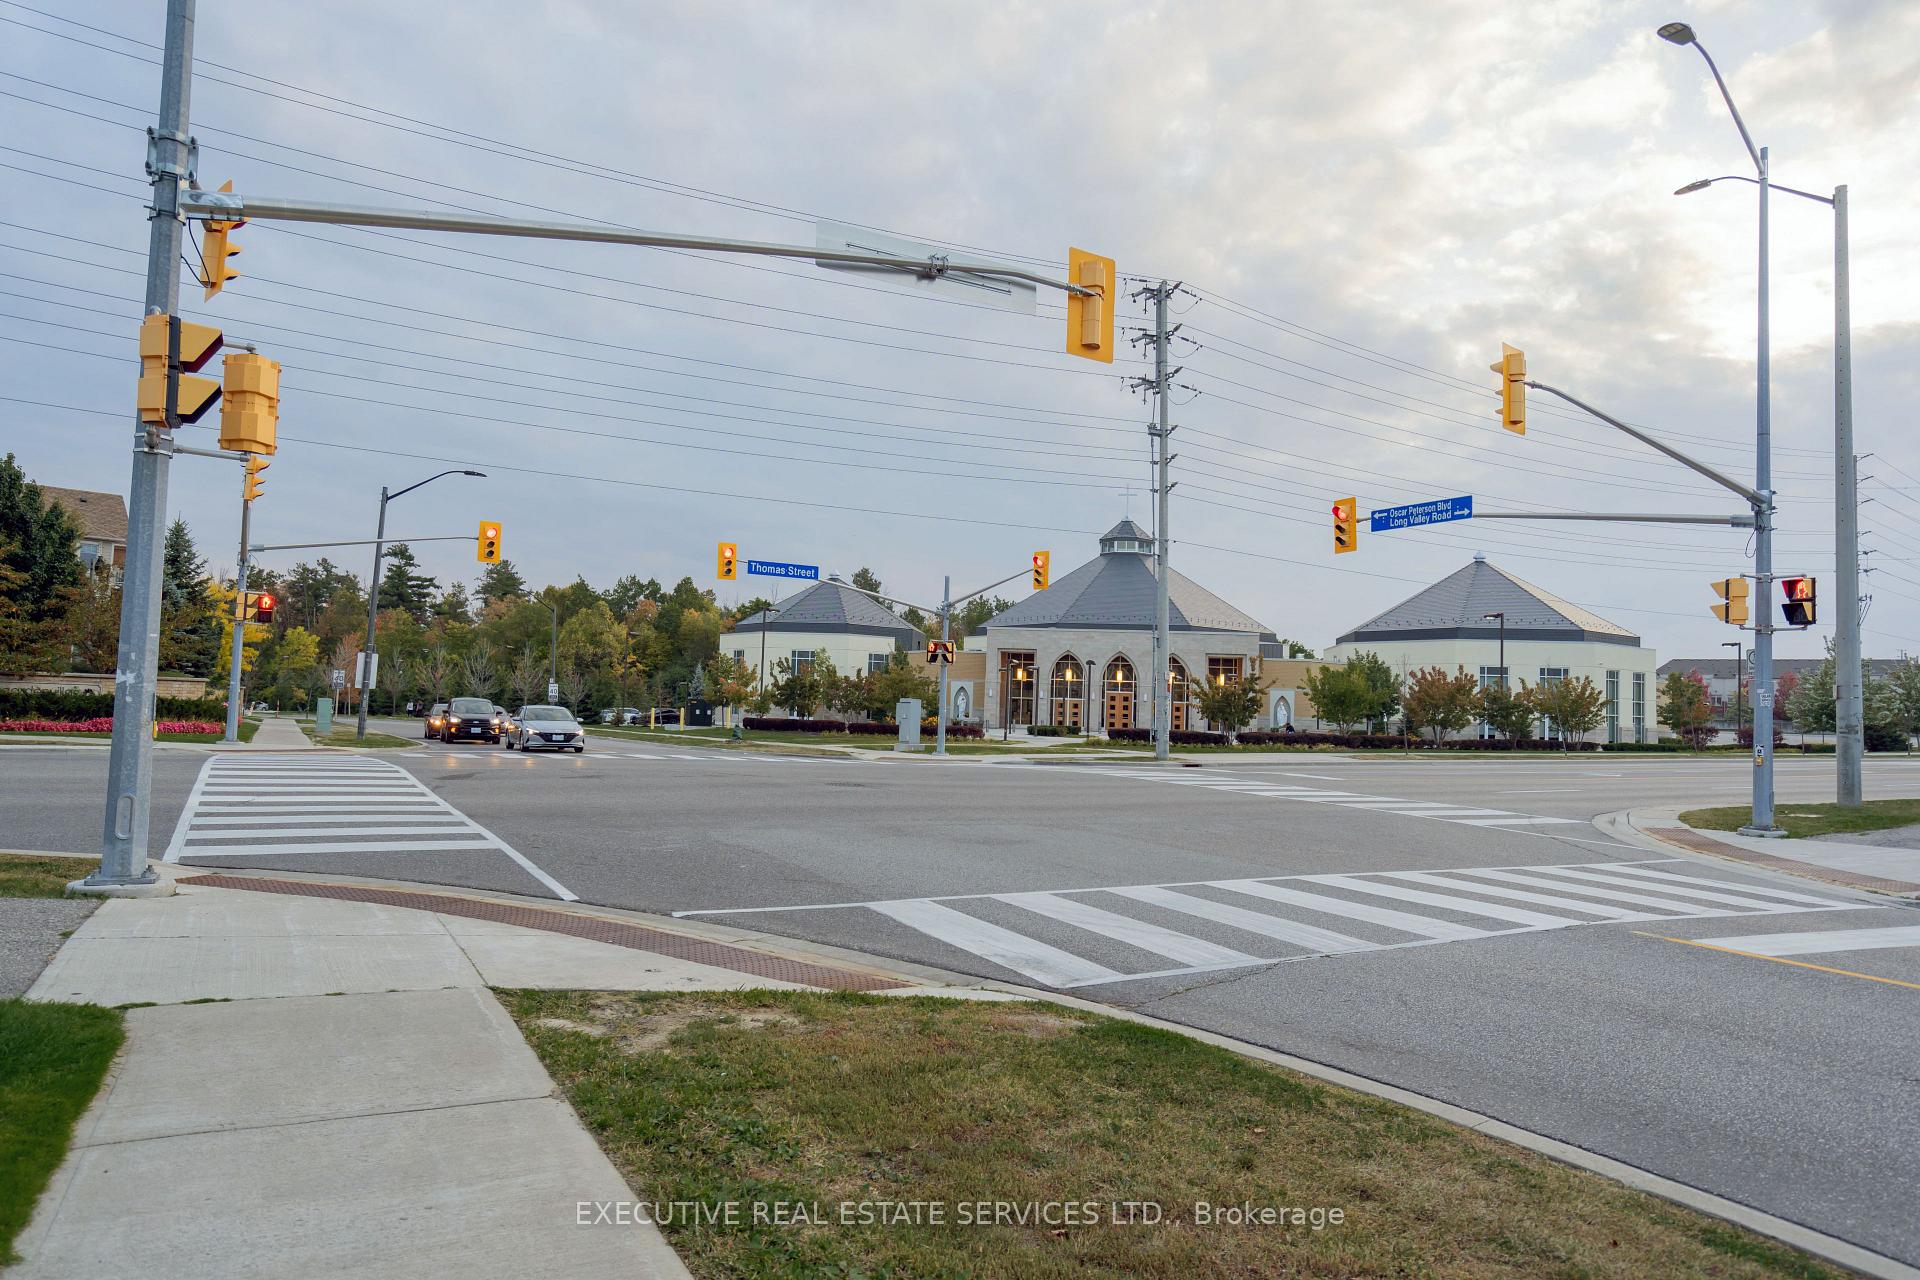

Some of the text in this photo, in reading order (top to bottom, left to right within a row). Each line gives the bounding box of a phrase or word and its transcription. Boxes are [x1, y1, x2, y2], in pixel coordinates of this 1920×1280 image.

[1389, 500, 1452, 518] Oscar Peterson Blvd
[1389, 510, 1452, 528] Long Valley Road
[750, 562, 815, 578] Thomas Street
